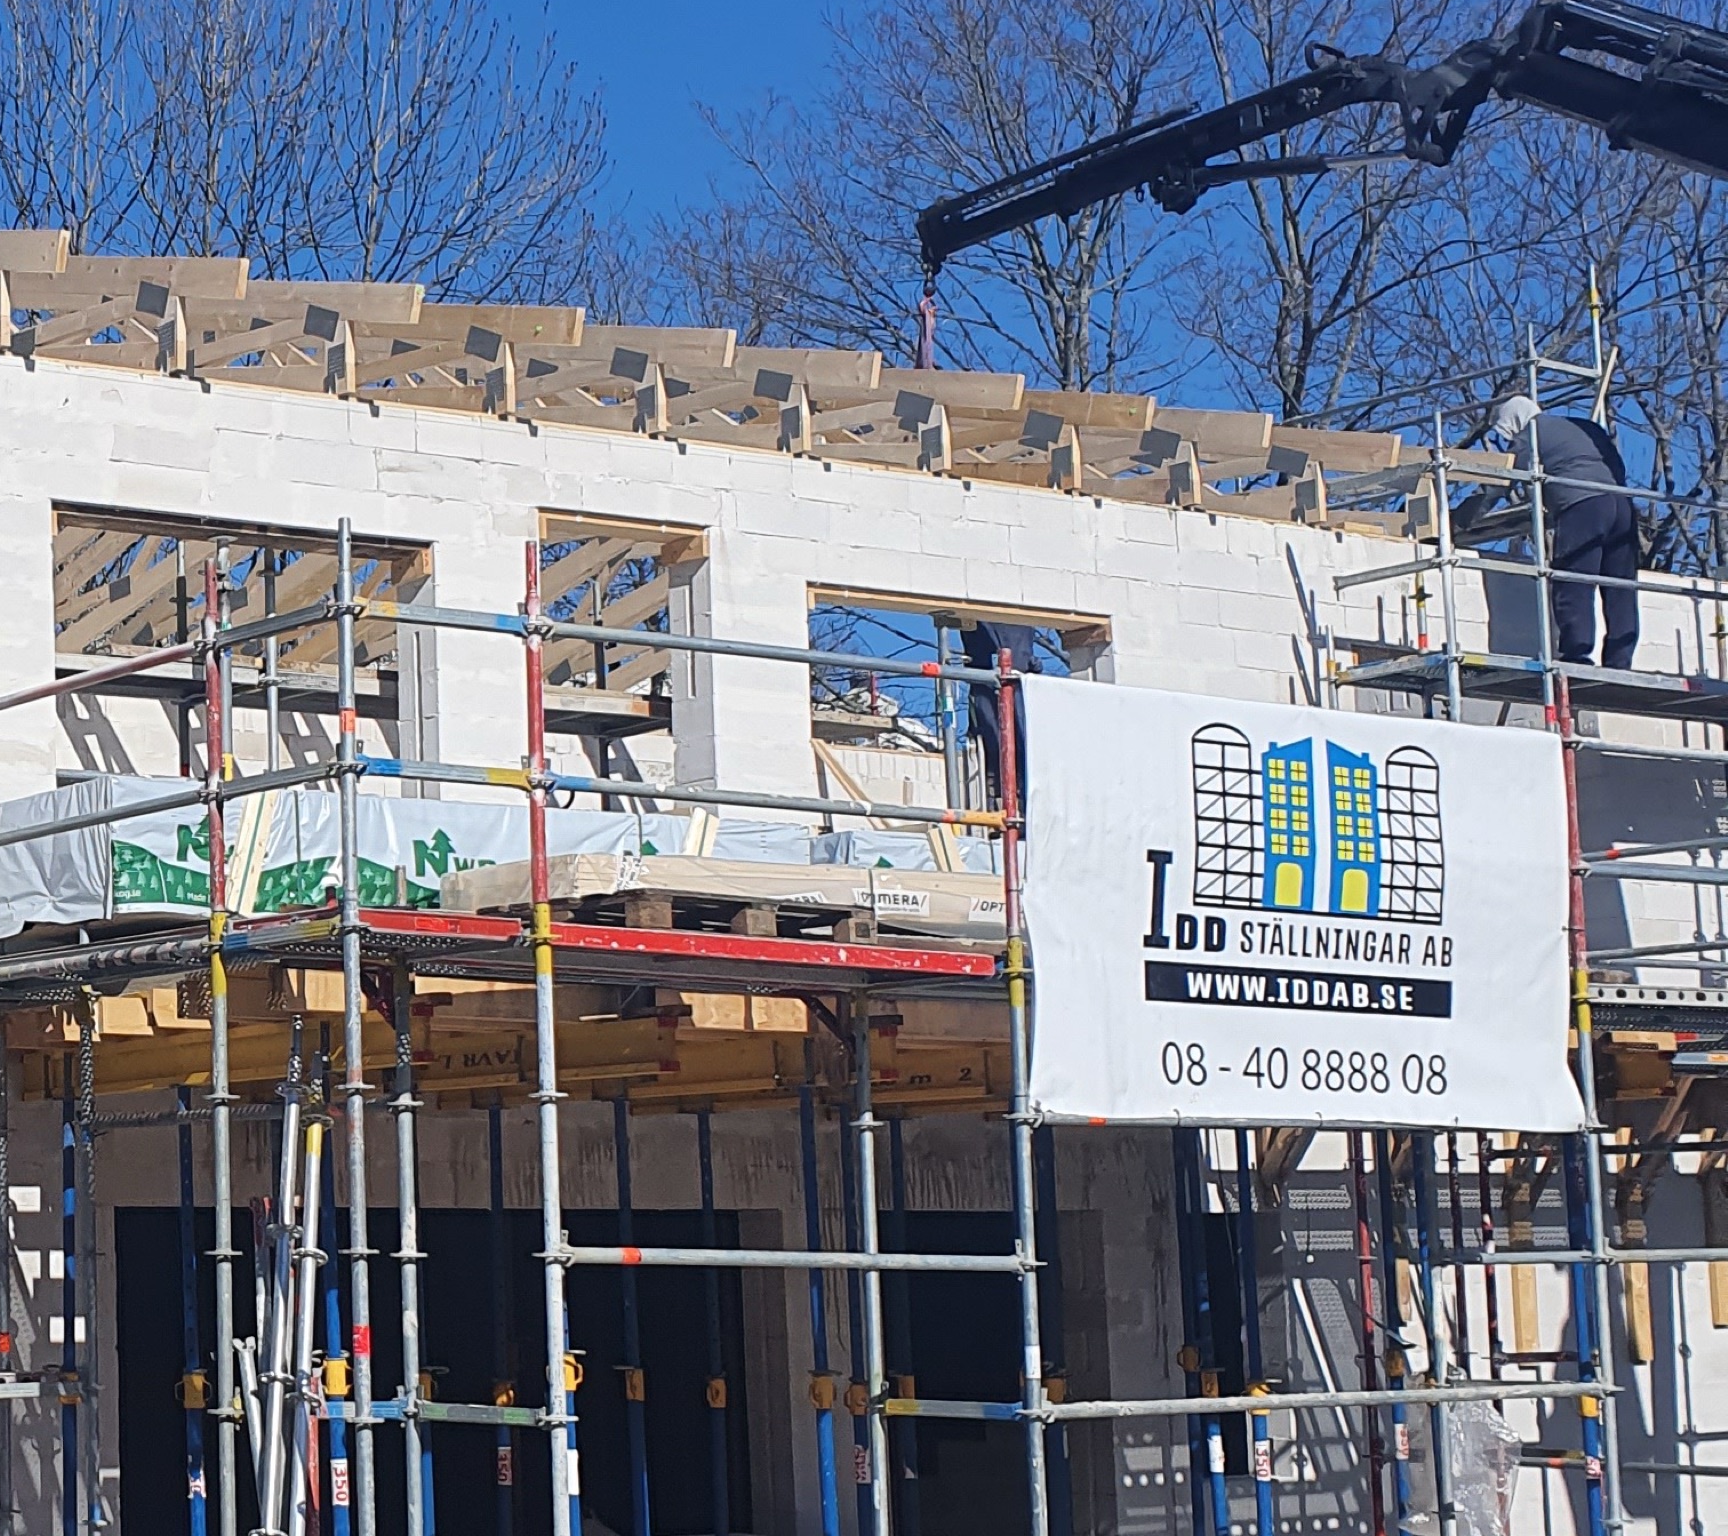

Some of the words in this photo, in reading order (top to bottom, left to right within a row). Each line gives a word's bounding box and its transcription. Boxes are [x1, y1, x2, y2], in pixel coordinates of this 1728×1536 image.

[1143, 849, 1227, 953] IDD
[1240, 918, 1411, 965] STÄLLNINGAR
[1422, 935, 1454, 967] AB
[1186, 971, 1414, 1012] WWW.IDDAB.SE
[1161, 1041, 1208, 1086] 08
[1242, 1046, 1289, 1089] 40
[1300, 1048, 1391, 1094] 8888
[1402, 1053, 1448, 1096] 08
[1255, 1447, 1270, 1477] 350
[333, 1467, 348, 1502] 350
